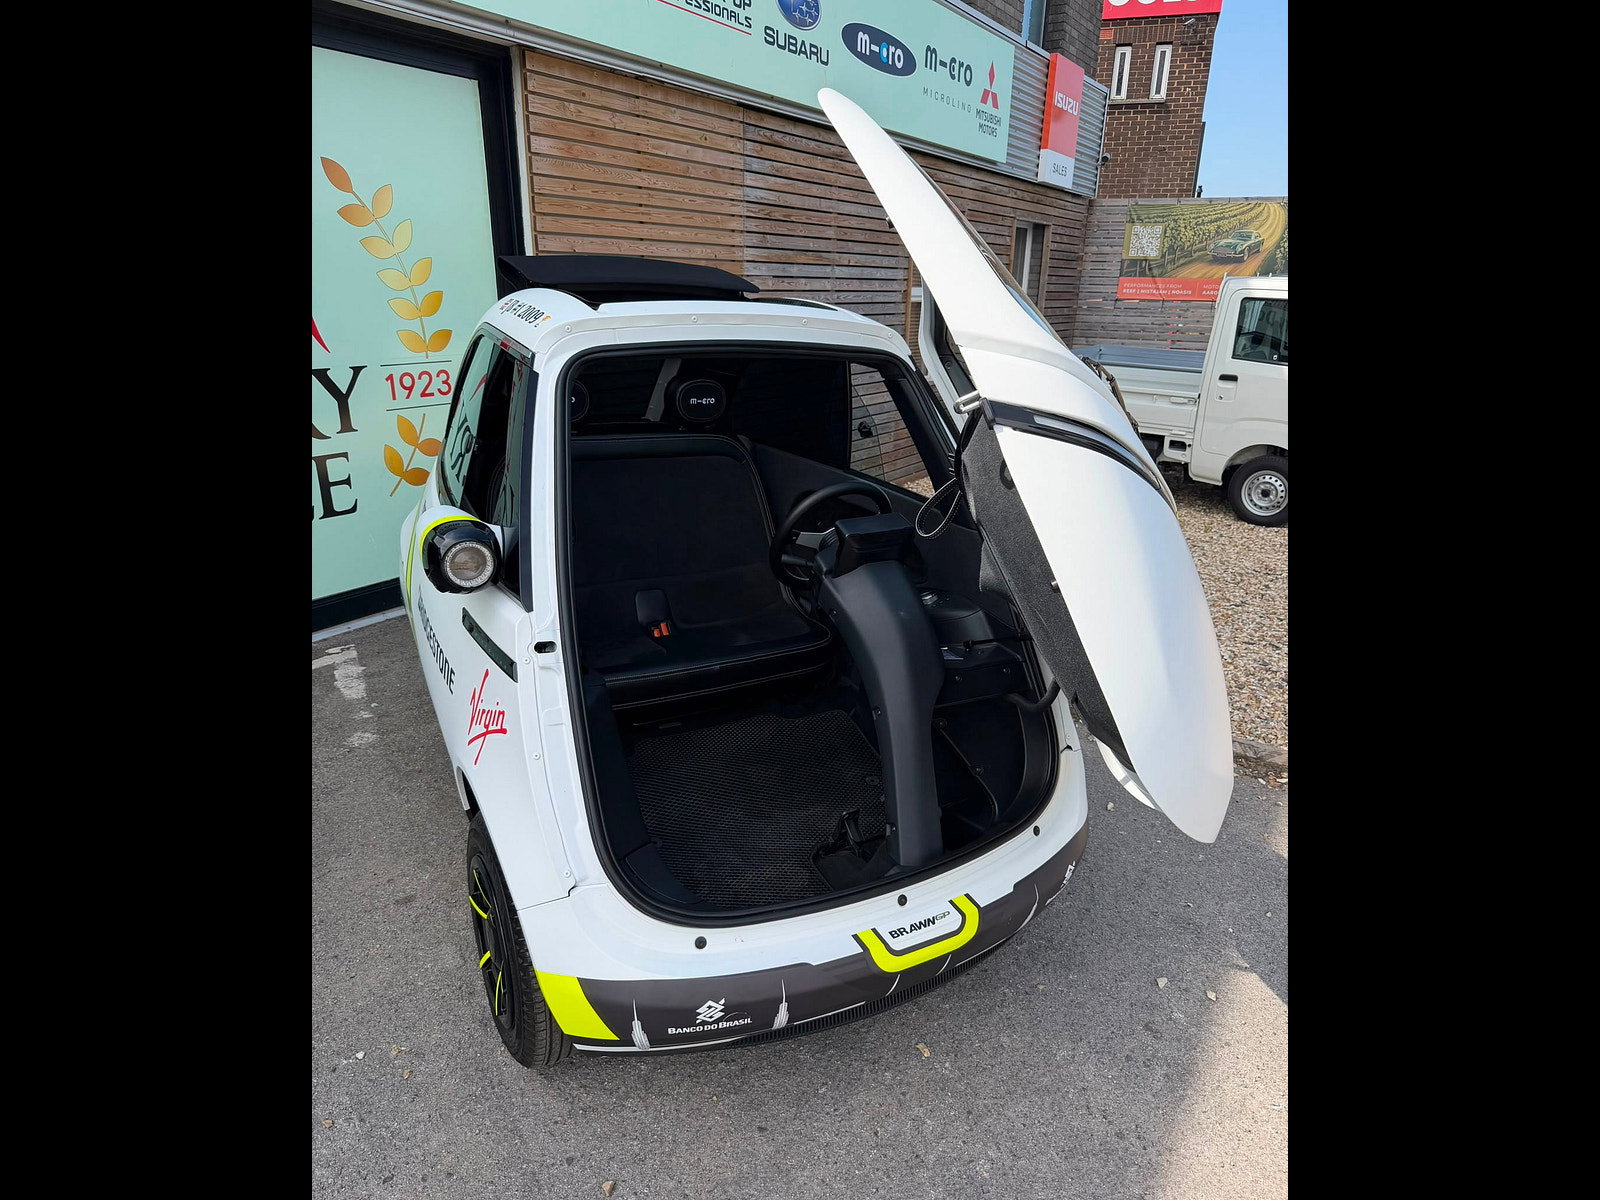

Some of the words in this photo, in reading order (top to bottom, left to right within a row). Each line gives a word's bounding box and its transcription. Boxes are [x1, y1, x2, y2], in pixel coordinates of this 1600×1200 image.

[764, 25, 830, 66] SUBARU
[922, 86, 972, 113] MICROLINO
[1054, 91, 1079, 116] ISUZU
[975, 108, 1002, 127] MITSUBISHI
[978, 122, 998, 138] MOTORS
[1052, 162, 1068, 177] SALES
[384, 369, 452, 401] 1923
[467, 668, 508, 766] Virgin
